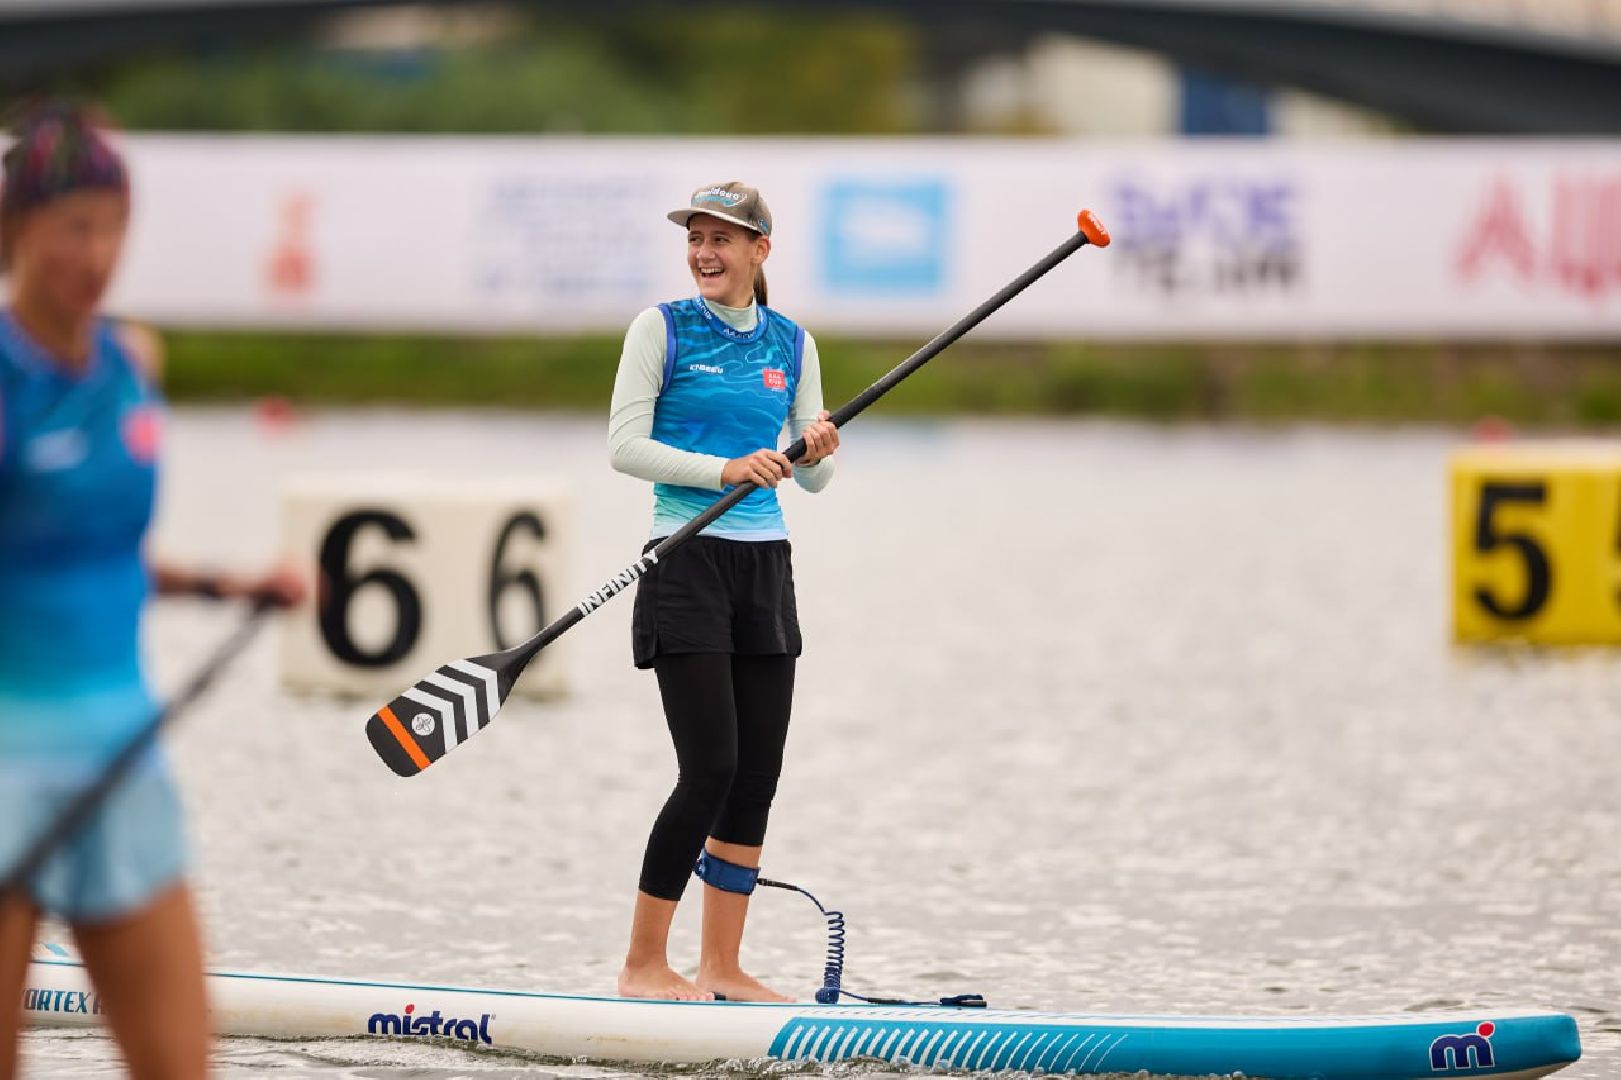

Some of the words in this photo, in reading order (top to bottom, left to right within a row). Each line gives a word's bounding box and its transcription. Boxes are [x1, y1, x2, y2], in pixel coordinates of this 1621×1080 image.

[317, 508, 422, 668] 6
[487, 512, 547, 667] 6
[577, 547, 658, 617] INFINITY
[1475, 481, 1552, 622] 5
[23, 988, 91, 1015] ORTEX
[367, 1003, 492, 1044] mistral
